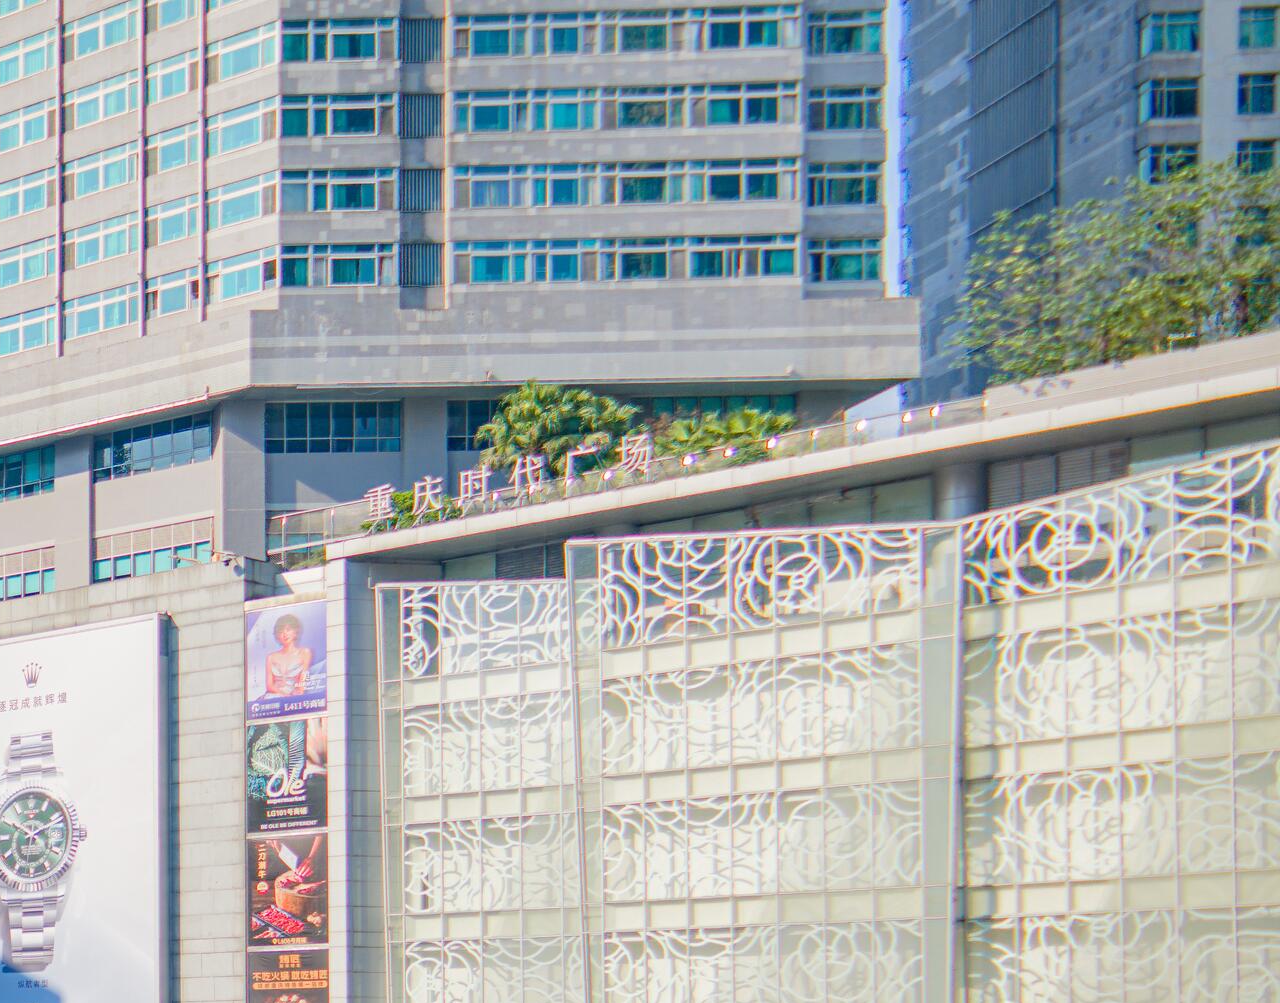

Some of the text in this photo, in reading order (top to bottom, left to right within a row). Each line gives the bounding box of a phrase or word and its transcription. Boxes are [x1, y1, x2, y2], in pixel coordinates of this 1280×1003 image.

[364, 433, 654, 520] 重庆时代广场
